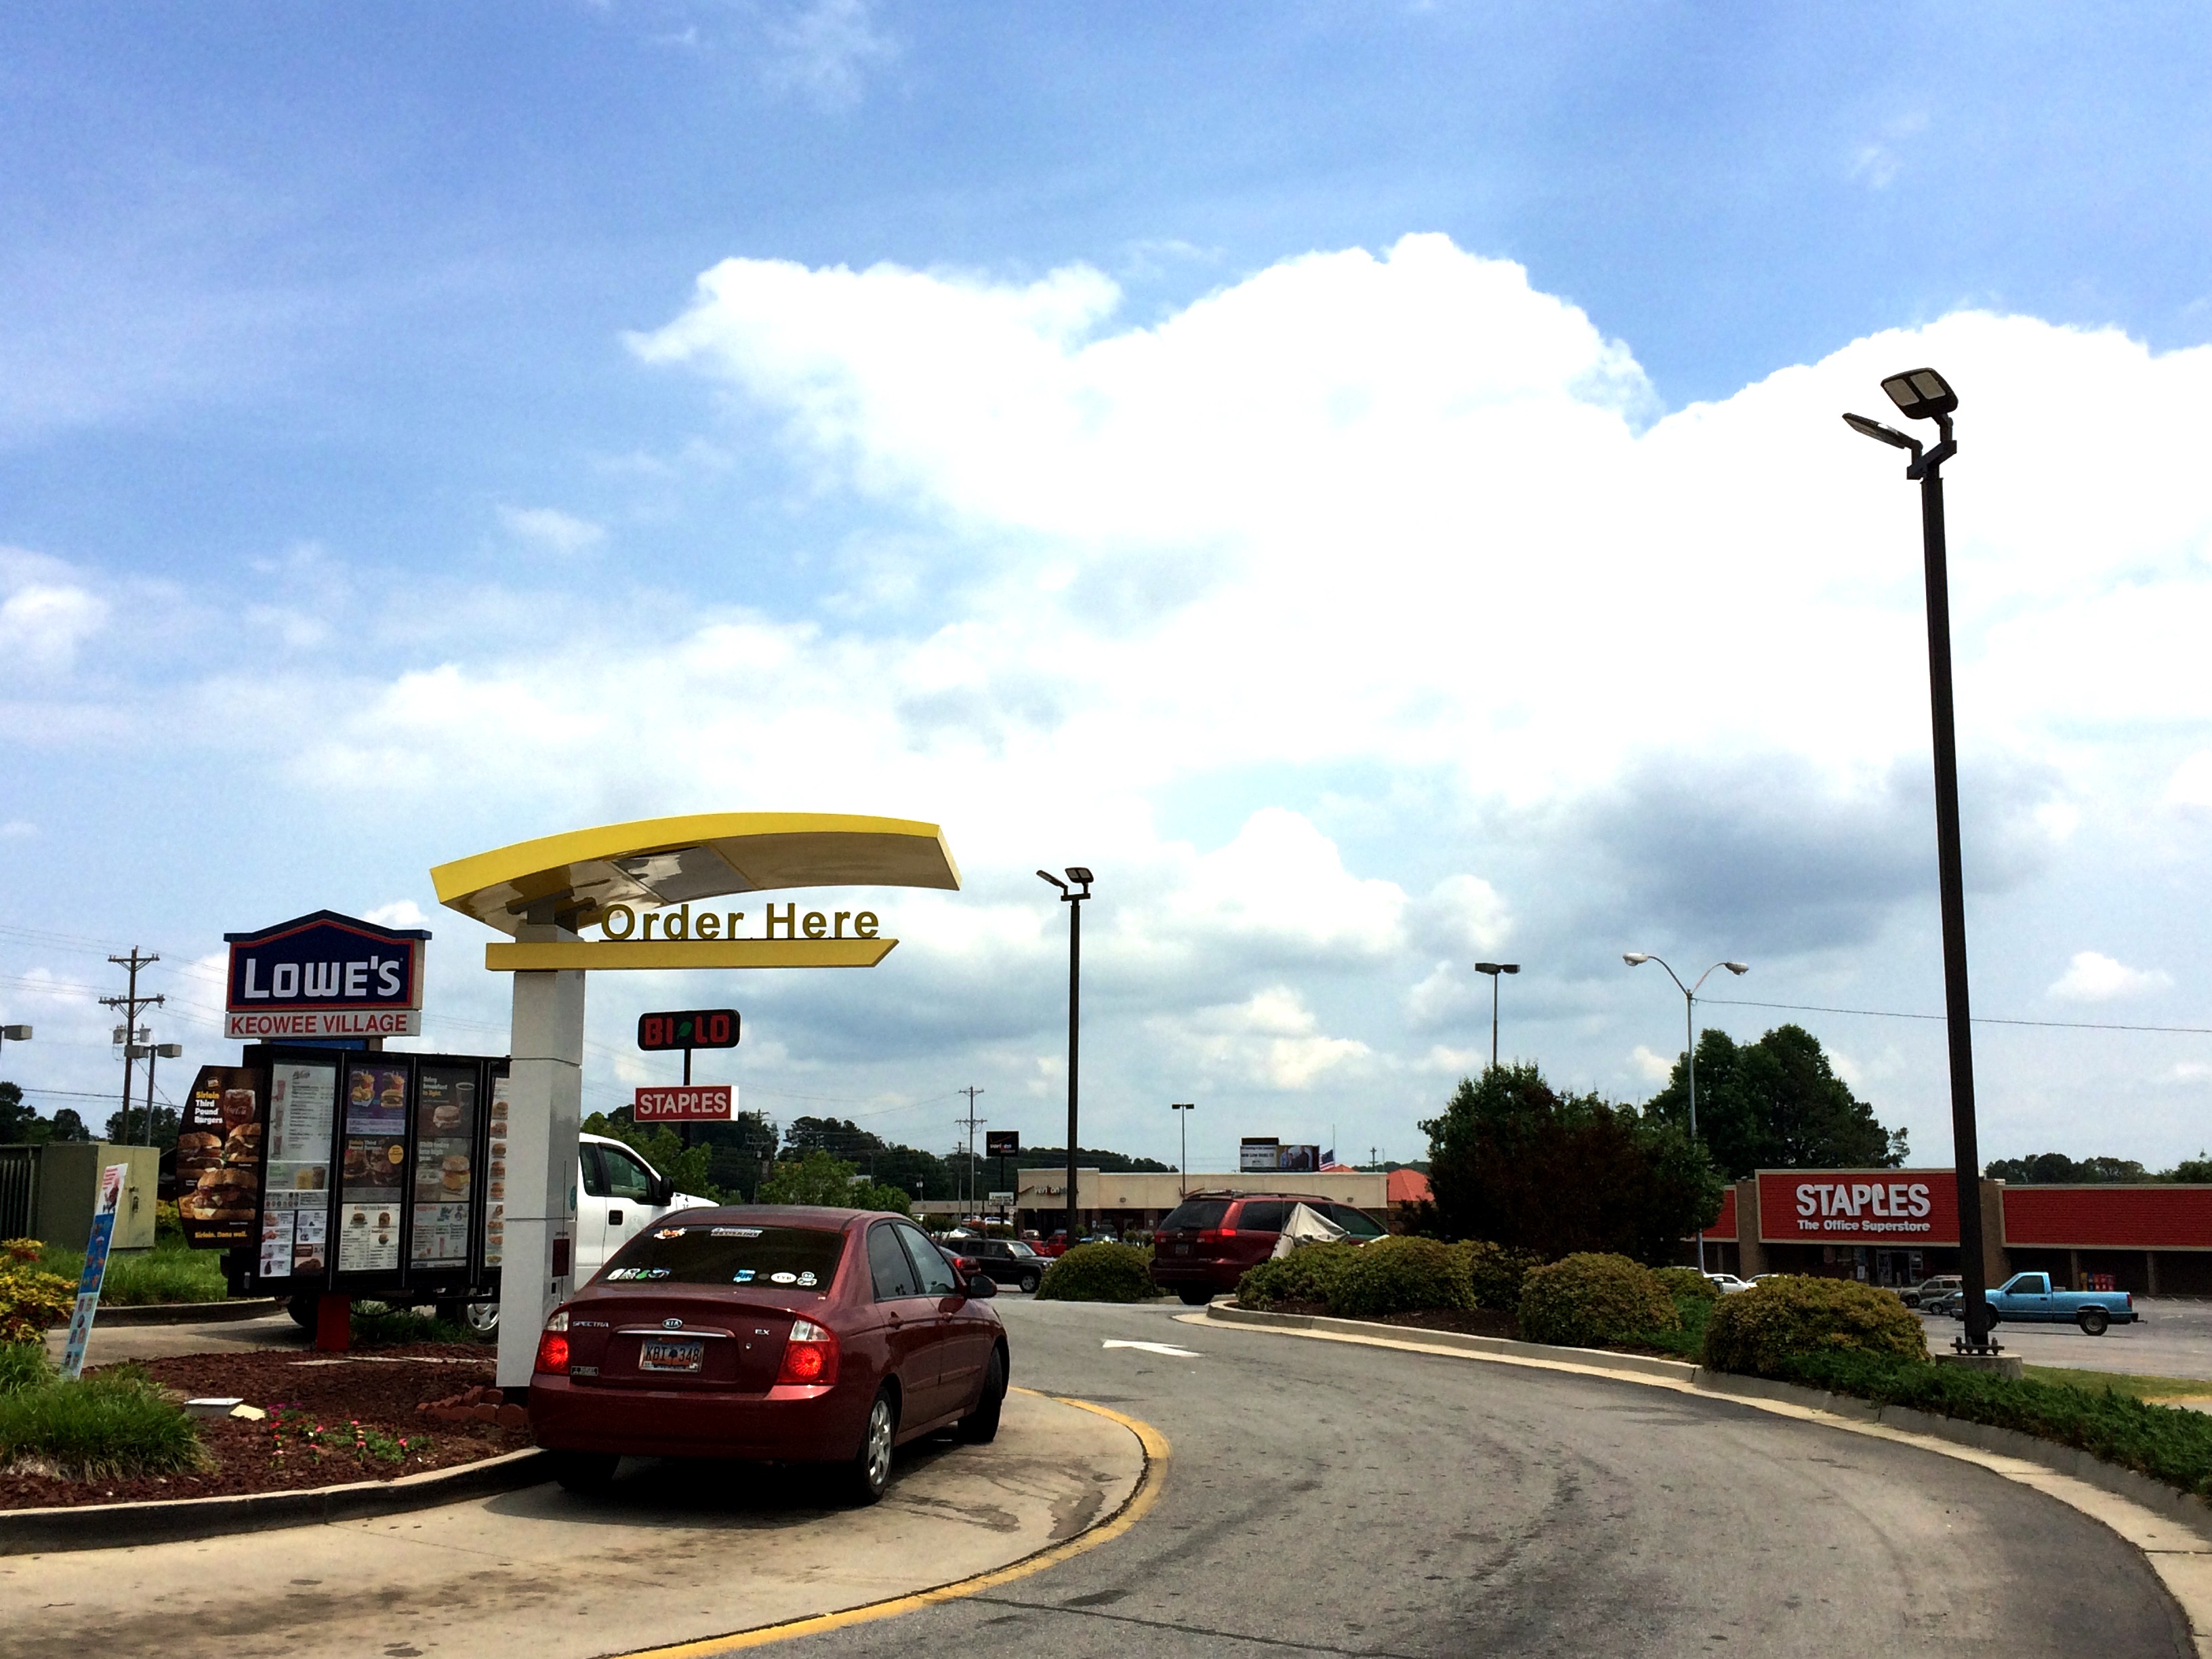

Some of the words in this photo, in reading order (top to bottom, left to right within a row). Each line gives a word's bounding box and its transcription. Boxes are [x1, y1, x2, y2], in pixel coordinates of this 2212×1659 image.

[601, 904, 744, 940] Order
[766, 903, 879, 939] Here
[245, 956, 401, 998] LOWE'S
[231, 1016, 316, 1034] KEOWEE
[323, 1014, 407, 1032] VILLAGE
[640, 1092, 726, 1114] STAPLES
[194, 1116, 223, 1125] Burgers
[1797, 1183, 1930, 1216] STAPLES
[1797, 1220, 1819, 1230] The
[1824, 1220, 1860, 1231] Office
[1861, 1221, 1930, 1233] Superstore
[678, 1347, 699, 1363] 348
